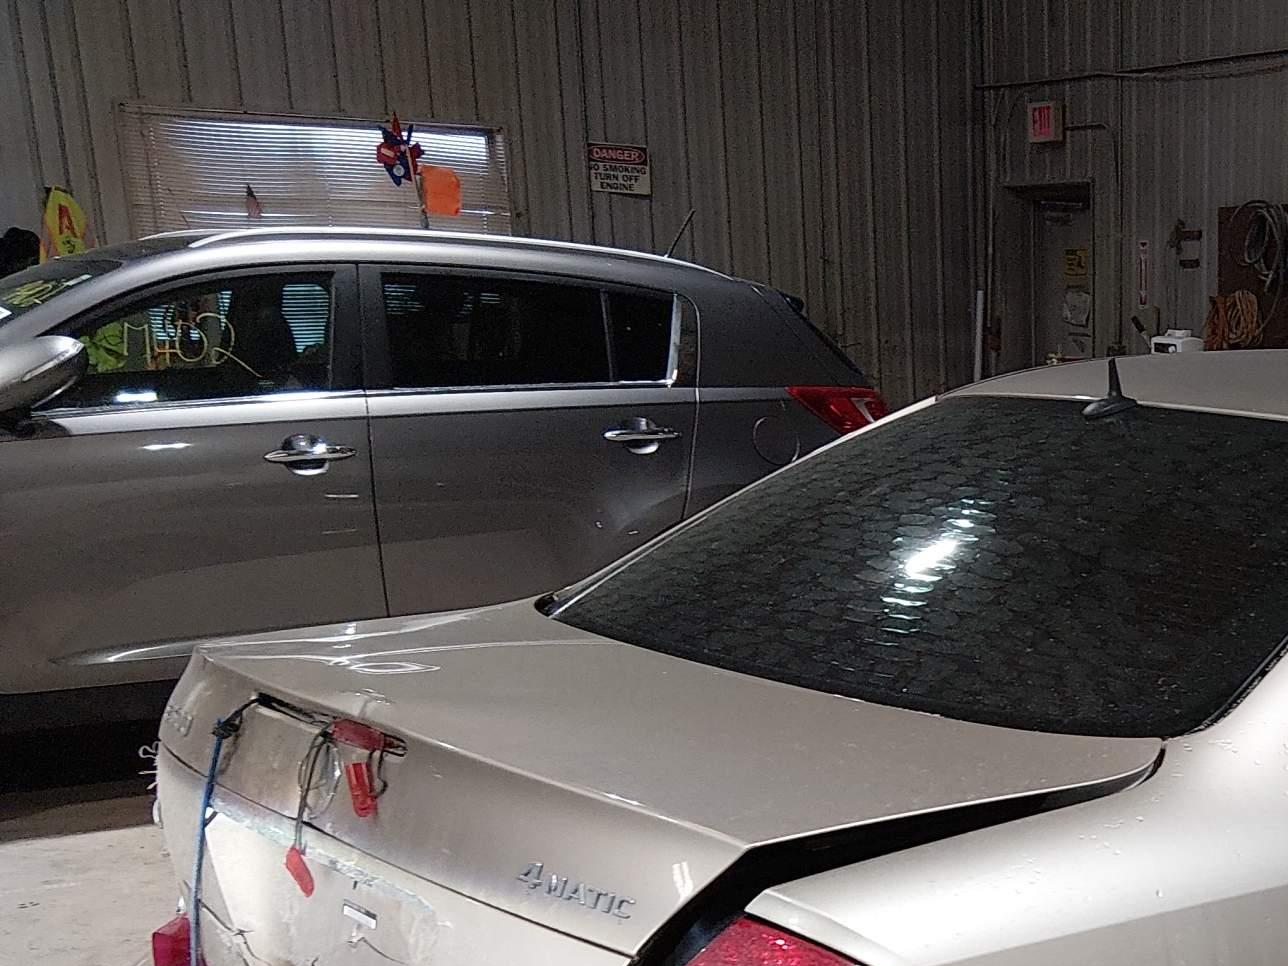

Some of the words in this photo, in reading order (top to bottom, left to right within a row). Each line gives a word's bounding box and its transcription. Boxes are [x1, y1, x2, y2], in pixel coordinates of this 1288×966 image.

[593, 147, 640, 161] DANGER
[602, 164, 647, 175] SMOKING
[593, 172, 618, 181] TURN
[622, 174, 640, 183] OFF
[600, 181, 635, 191] ENGINE
[517, 862, 636, 919] 4MATIC
